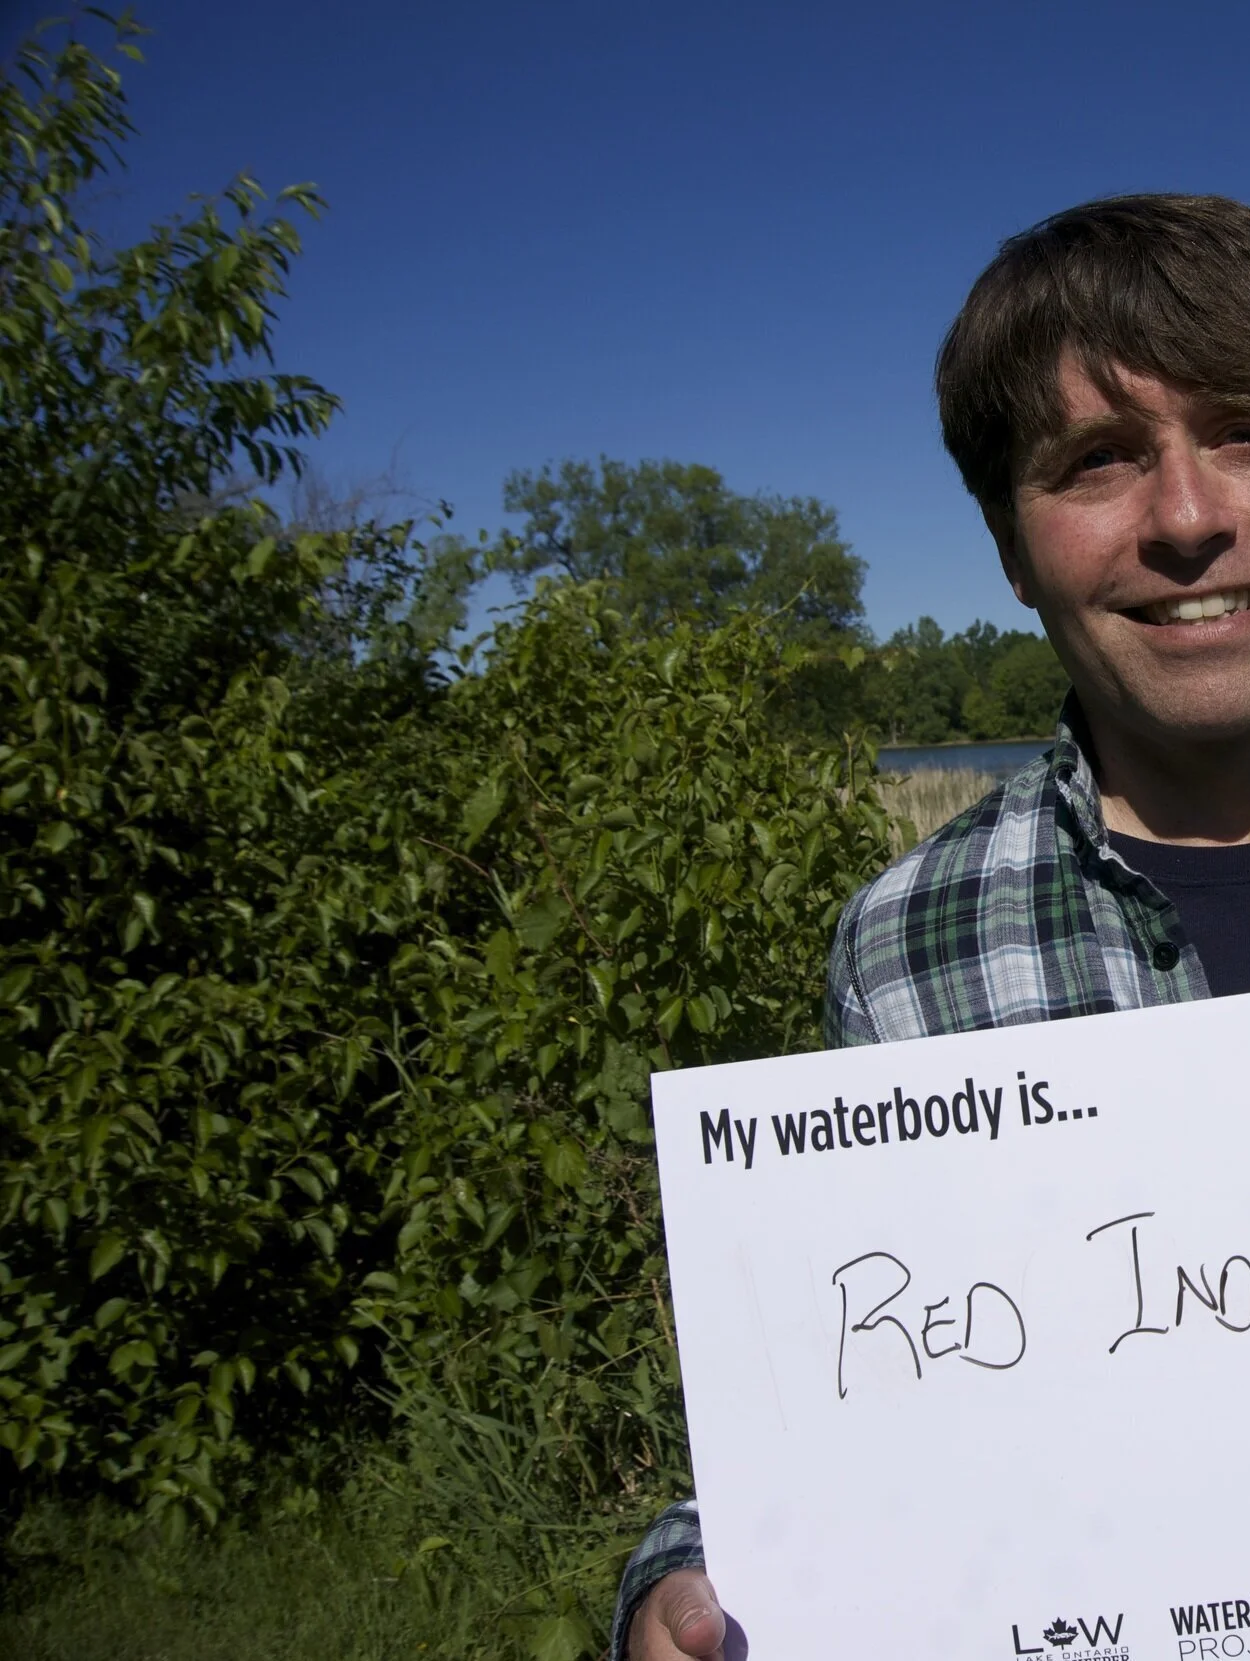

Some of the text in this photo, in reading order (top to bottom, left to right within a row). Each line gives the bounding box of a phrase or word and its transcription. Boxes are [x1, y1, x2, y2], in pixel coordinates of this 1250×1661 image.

[700, 1071, 1098, 1169] My waterbody is...
[833, 1252, 1027, 1400] RED
[1062, 1646, 1130, 1660] ONTARIO
